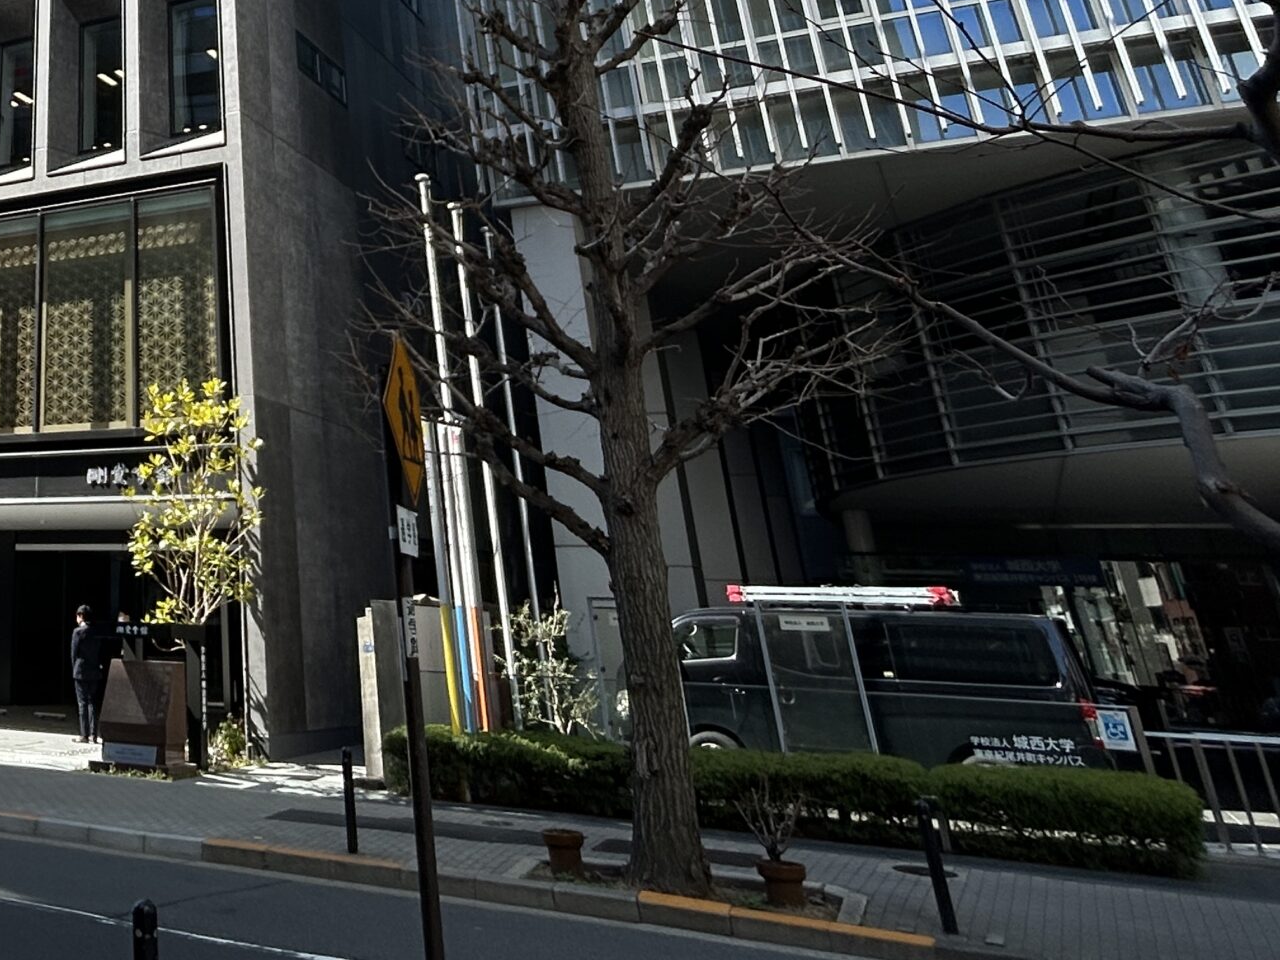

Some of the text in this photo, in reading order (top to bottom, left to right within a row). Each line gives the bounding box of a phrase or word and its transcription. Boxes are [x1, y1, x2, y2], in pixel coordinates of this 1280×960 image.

[969, 733, 1076, 753] 学校法人 城西大学
